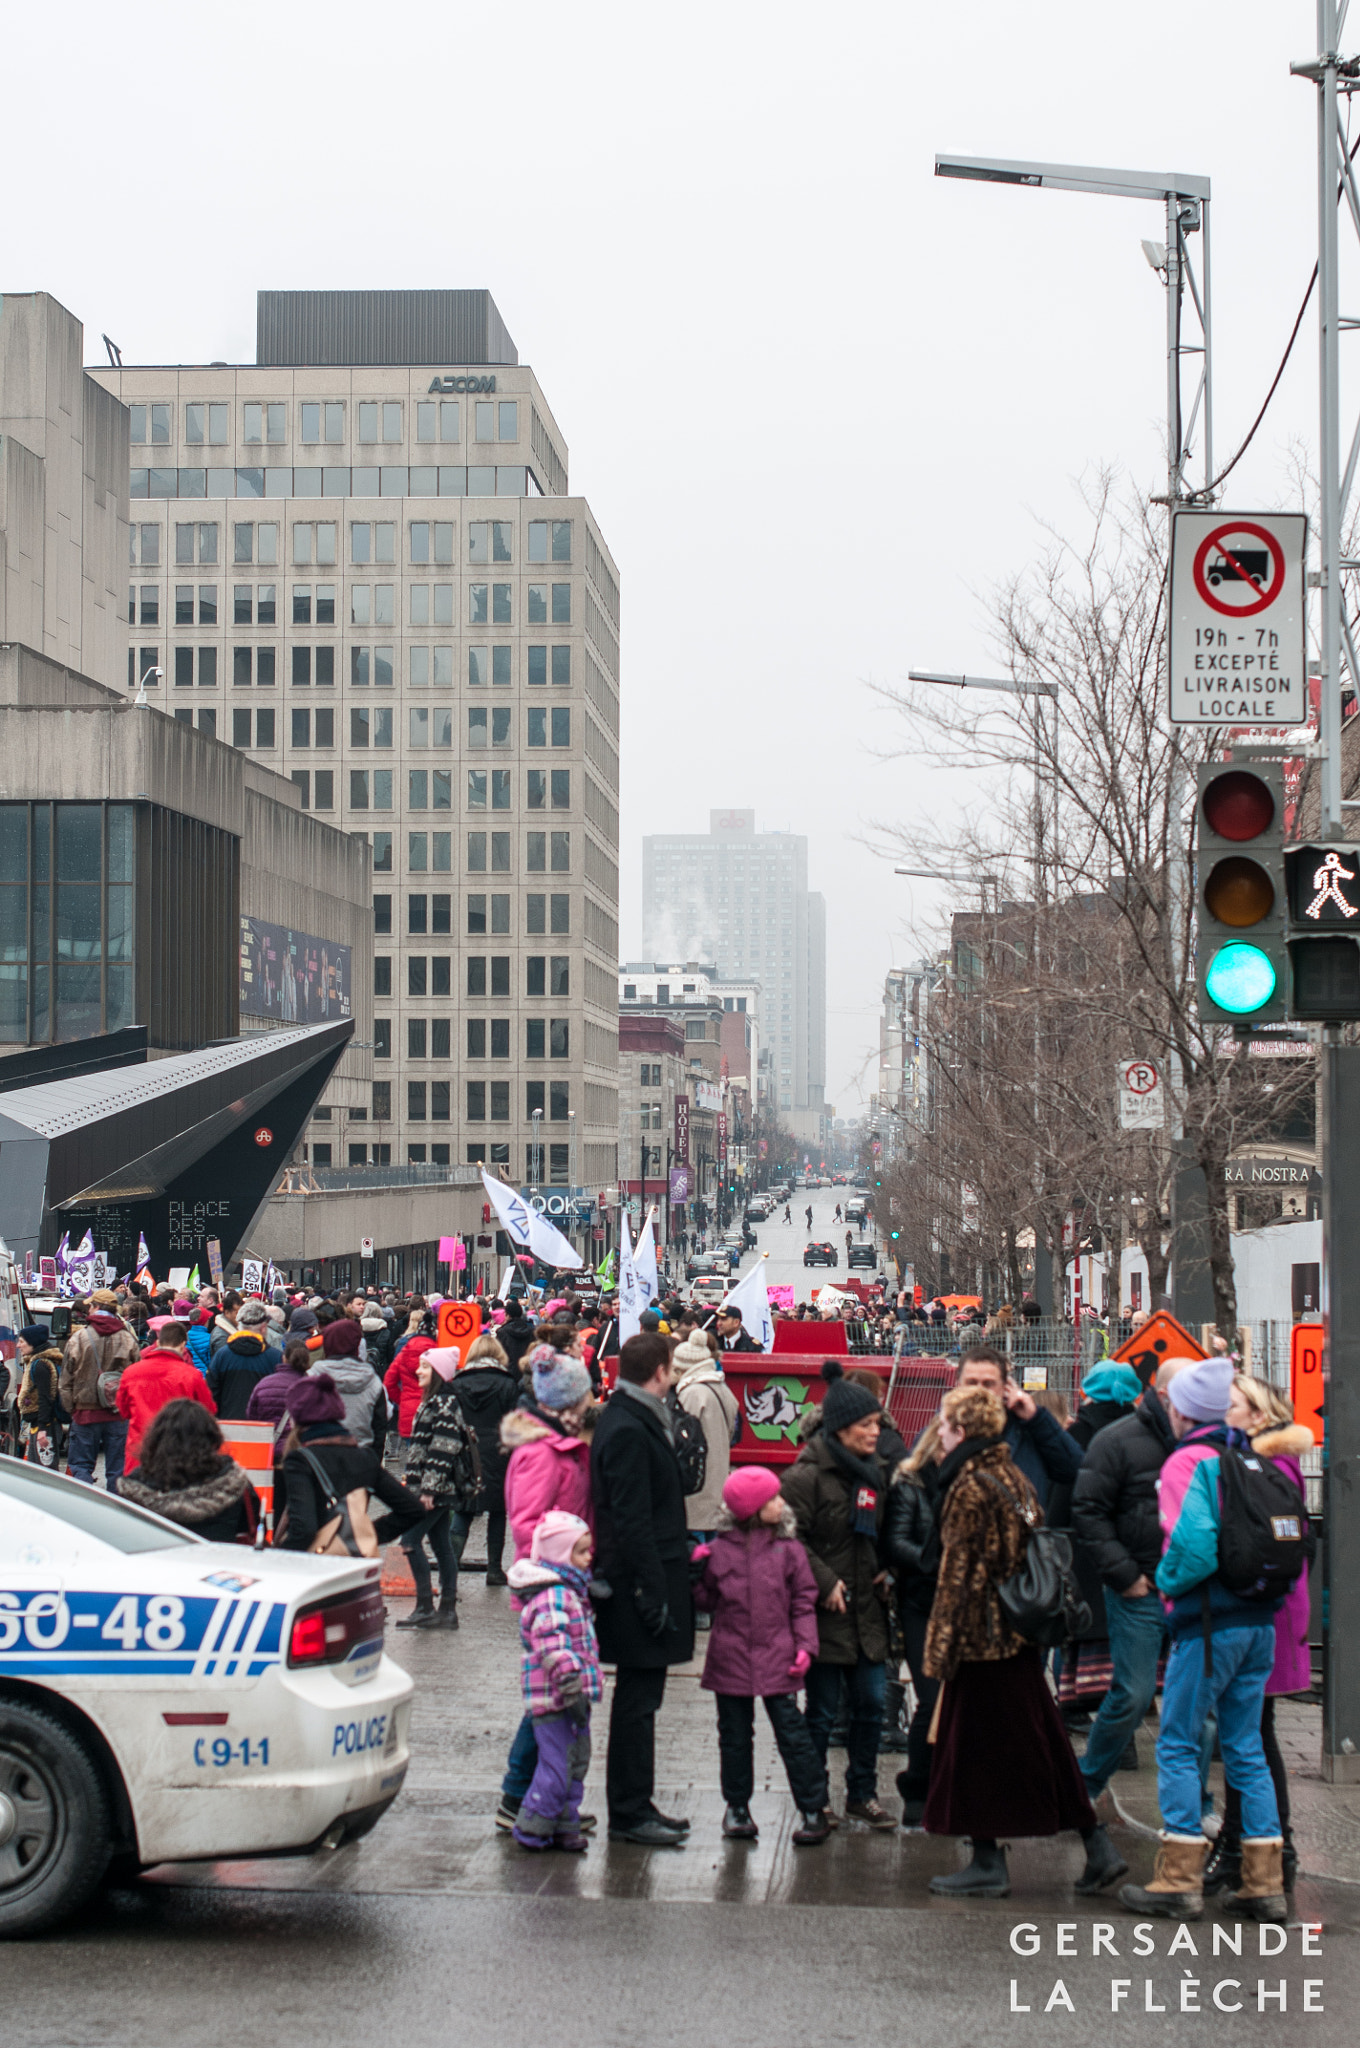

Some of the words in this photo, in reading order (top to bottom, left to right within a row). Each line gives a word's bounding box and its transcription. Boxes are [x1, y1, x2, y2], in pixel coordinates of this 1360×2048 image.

[428, 375, 496, 394] AECOM
[1196, 628, 1227, 647] 19h
[1255, 629, 1278, 647] 7h
[1195, 651, 1280, 670] EXCEPTÉ
[1185, 677, 1290, 693] LIVRAISON
[1200, 701, 1275, 716] LOCALE
[678, 1104, 688, 1158] HÔTEL
[1252, 1167, 1309, 1181] NOSTRA
[169, 1201, 230, 1216] PLACE
[169, 1218, 205, 1233] DES
[169, 1234, 218, 1250] ART
[244, 1282, 260, 1291] CSN
[332, 1715, 387, 1756] POLICE
[212, 1738, 270, 1766] 9-1-1
